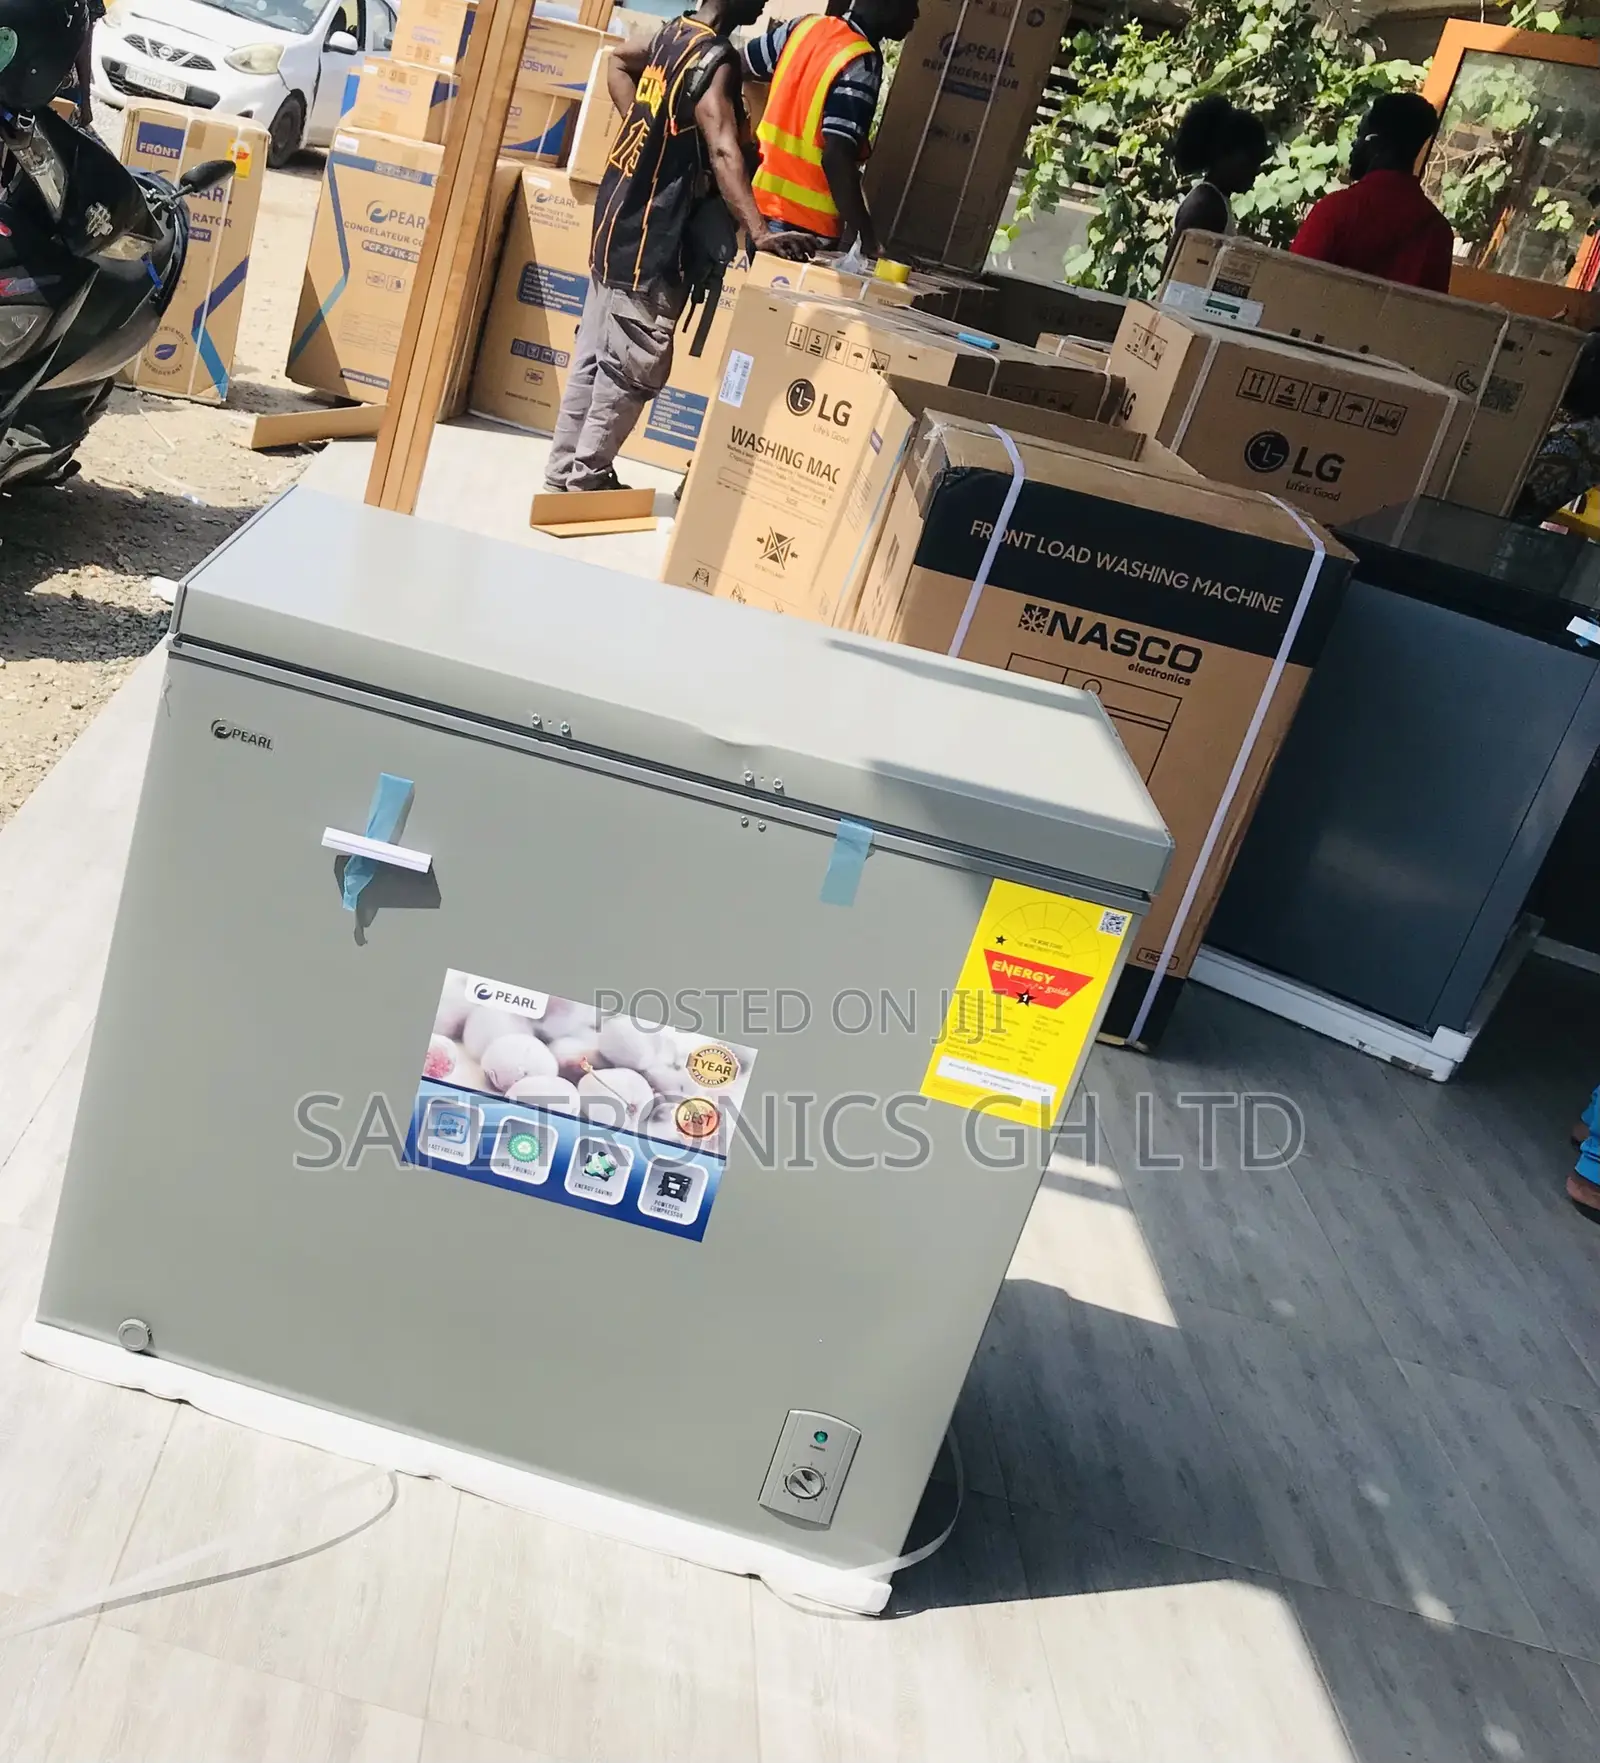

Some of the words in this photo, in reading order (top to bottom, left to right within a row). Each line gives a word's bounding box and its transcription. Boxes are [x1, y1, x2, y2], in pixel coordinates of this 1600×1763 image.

[139, 142, 179, 158] FRONT
[388, 209, 426, 230] PEAR
[344, 220, 411, 243] CONGELATEUR
[817, 393, 853, 427] LG
[813, 424, 830, 436] Life's
[831, 429, 850, 444] Good
[731, 425, 803, 469] WASHING
[1292, 445, 1346, 483] LG
[1285, 479, 1312, 495] Life's
[1313, 487, 1342, 501] Good
[1037, 537, 1091, 564] LOAD
[1096, 552, 1190, 589] WASHING
[1191, 577, 1284, 614] MACHINE
[1046, 610, 1204, 674] NASCO
[1128, 662, 1192, 687] electronics
[232, 728, 274, 751] PEARL
[991, 960, 1056, 985] ENERGY
[495, 990, 538, 1010] PEARL
[1044, 985, 1073, 997] guide
[692, 1058, 699, 1068] 1
[700, 1060, 732, 1077] YEAR
[683, 1111, 713, 1127] BEST
